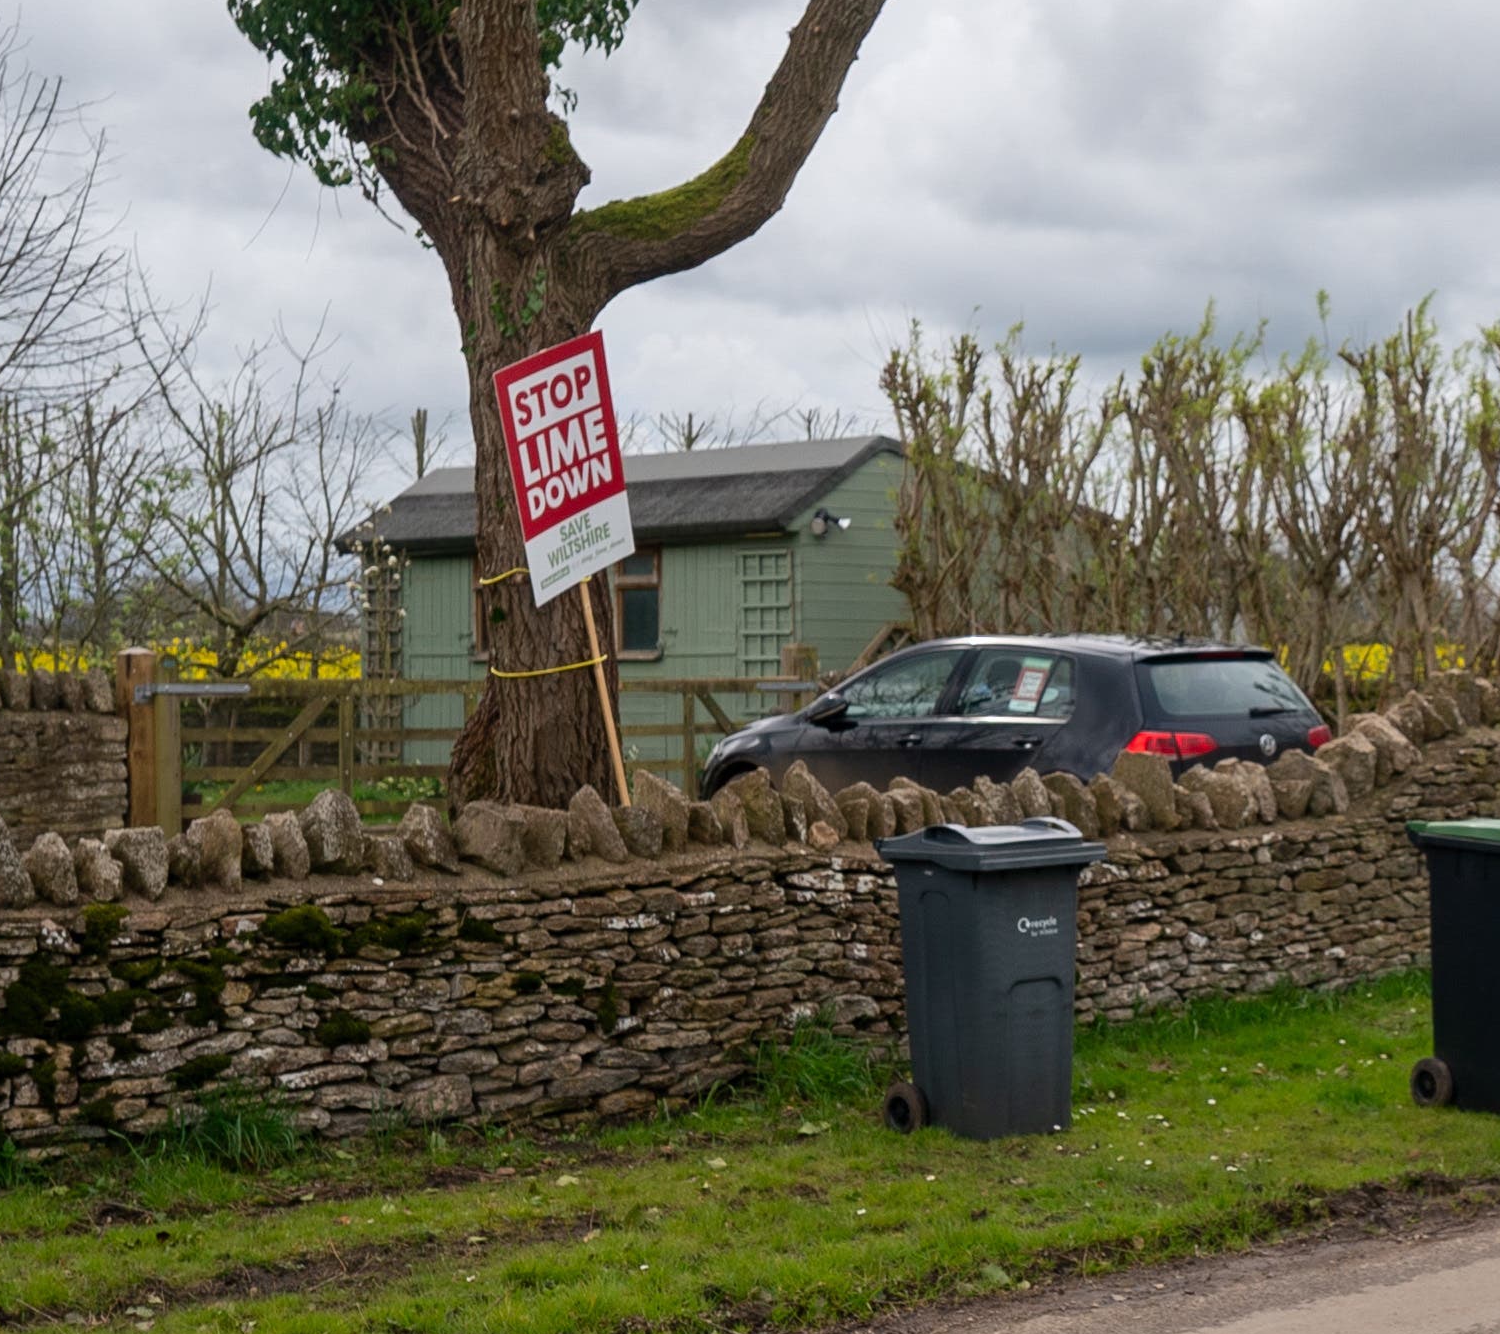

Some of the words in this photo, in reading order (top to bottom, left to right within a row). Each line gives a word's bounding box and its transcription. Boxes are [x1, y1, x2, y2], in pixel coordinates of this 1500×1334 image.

[515, 365, 591, 426] STOP
[519, 408, 607, 487] LIME
[527, 452, 613, 520] DOWN
[548, 522, 610, 569] WILTSHIRE
[559, 513, 591, 542] SAVE
